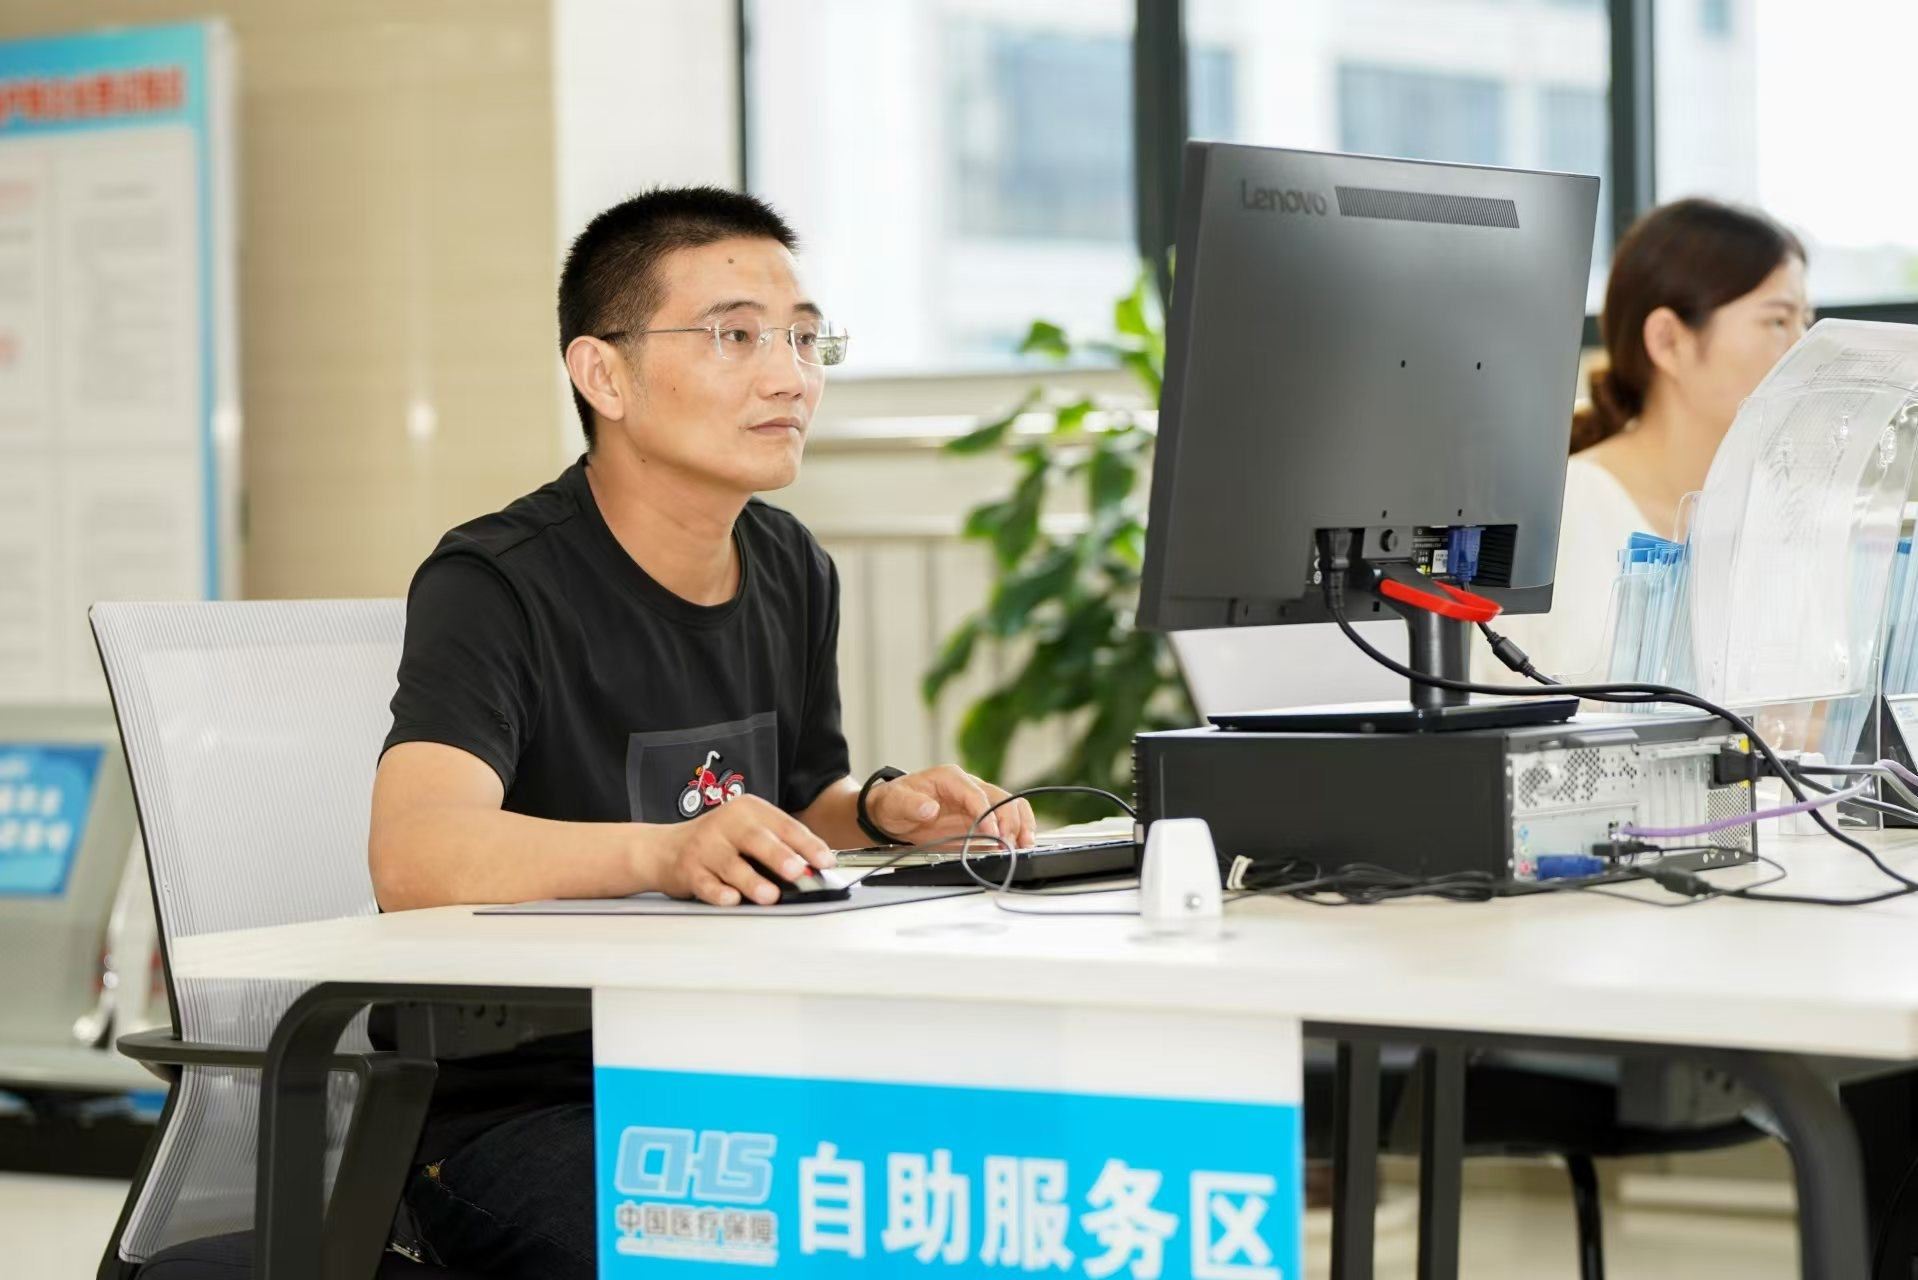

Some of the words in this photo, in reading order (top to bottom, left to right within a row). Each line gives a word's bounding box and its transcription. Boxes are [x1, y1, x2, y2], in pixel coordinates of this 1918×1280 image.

[1240, 179, 1328, 216] Lenovo
[615, 1126, 777, 1205] CHS
[617, 1202, 777, 1243] 中国医疗保障
[798, 1141, 1281, 1279] 自助服务区
